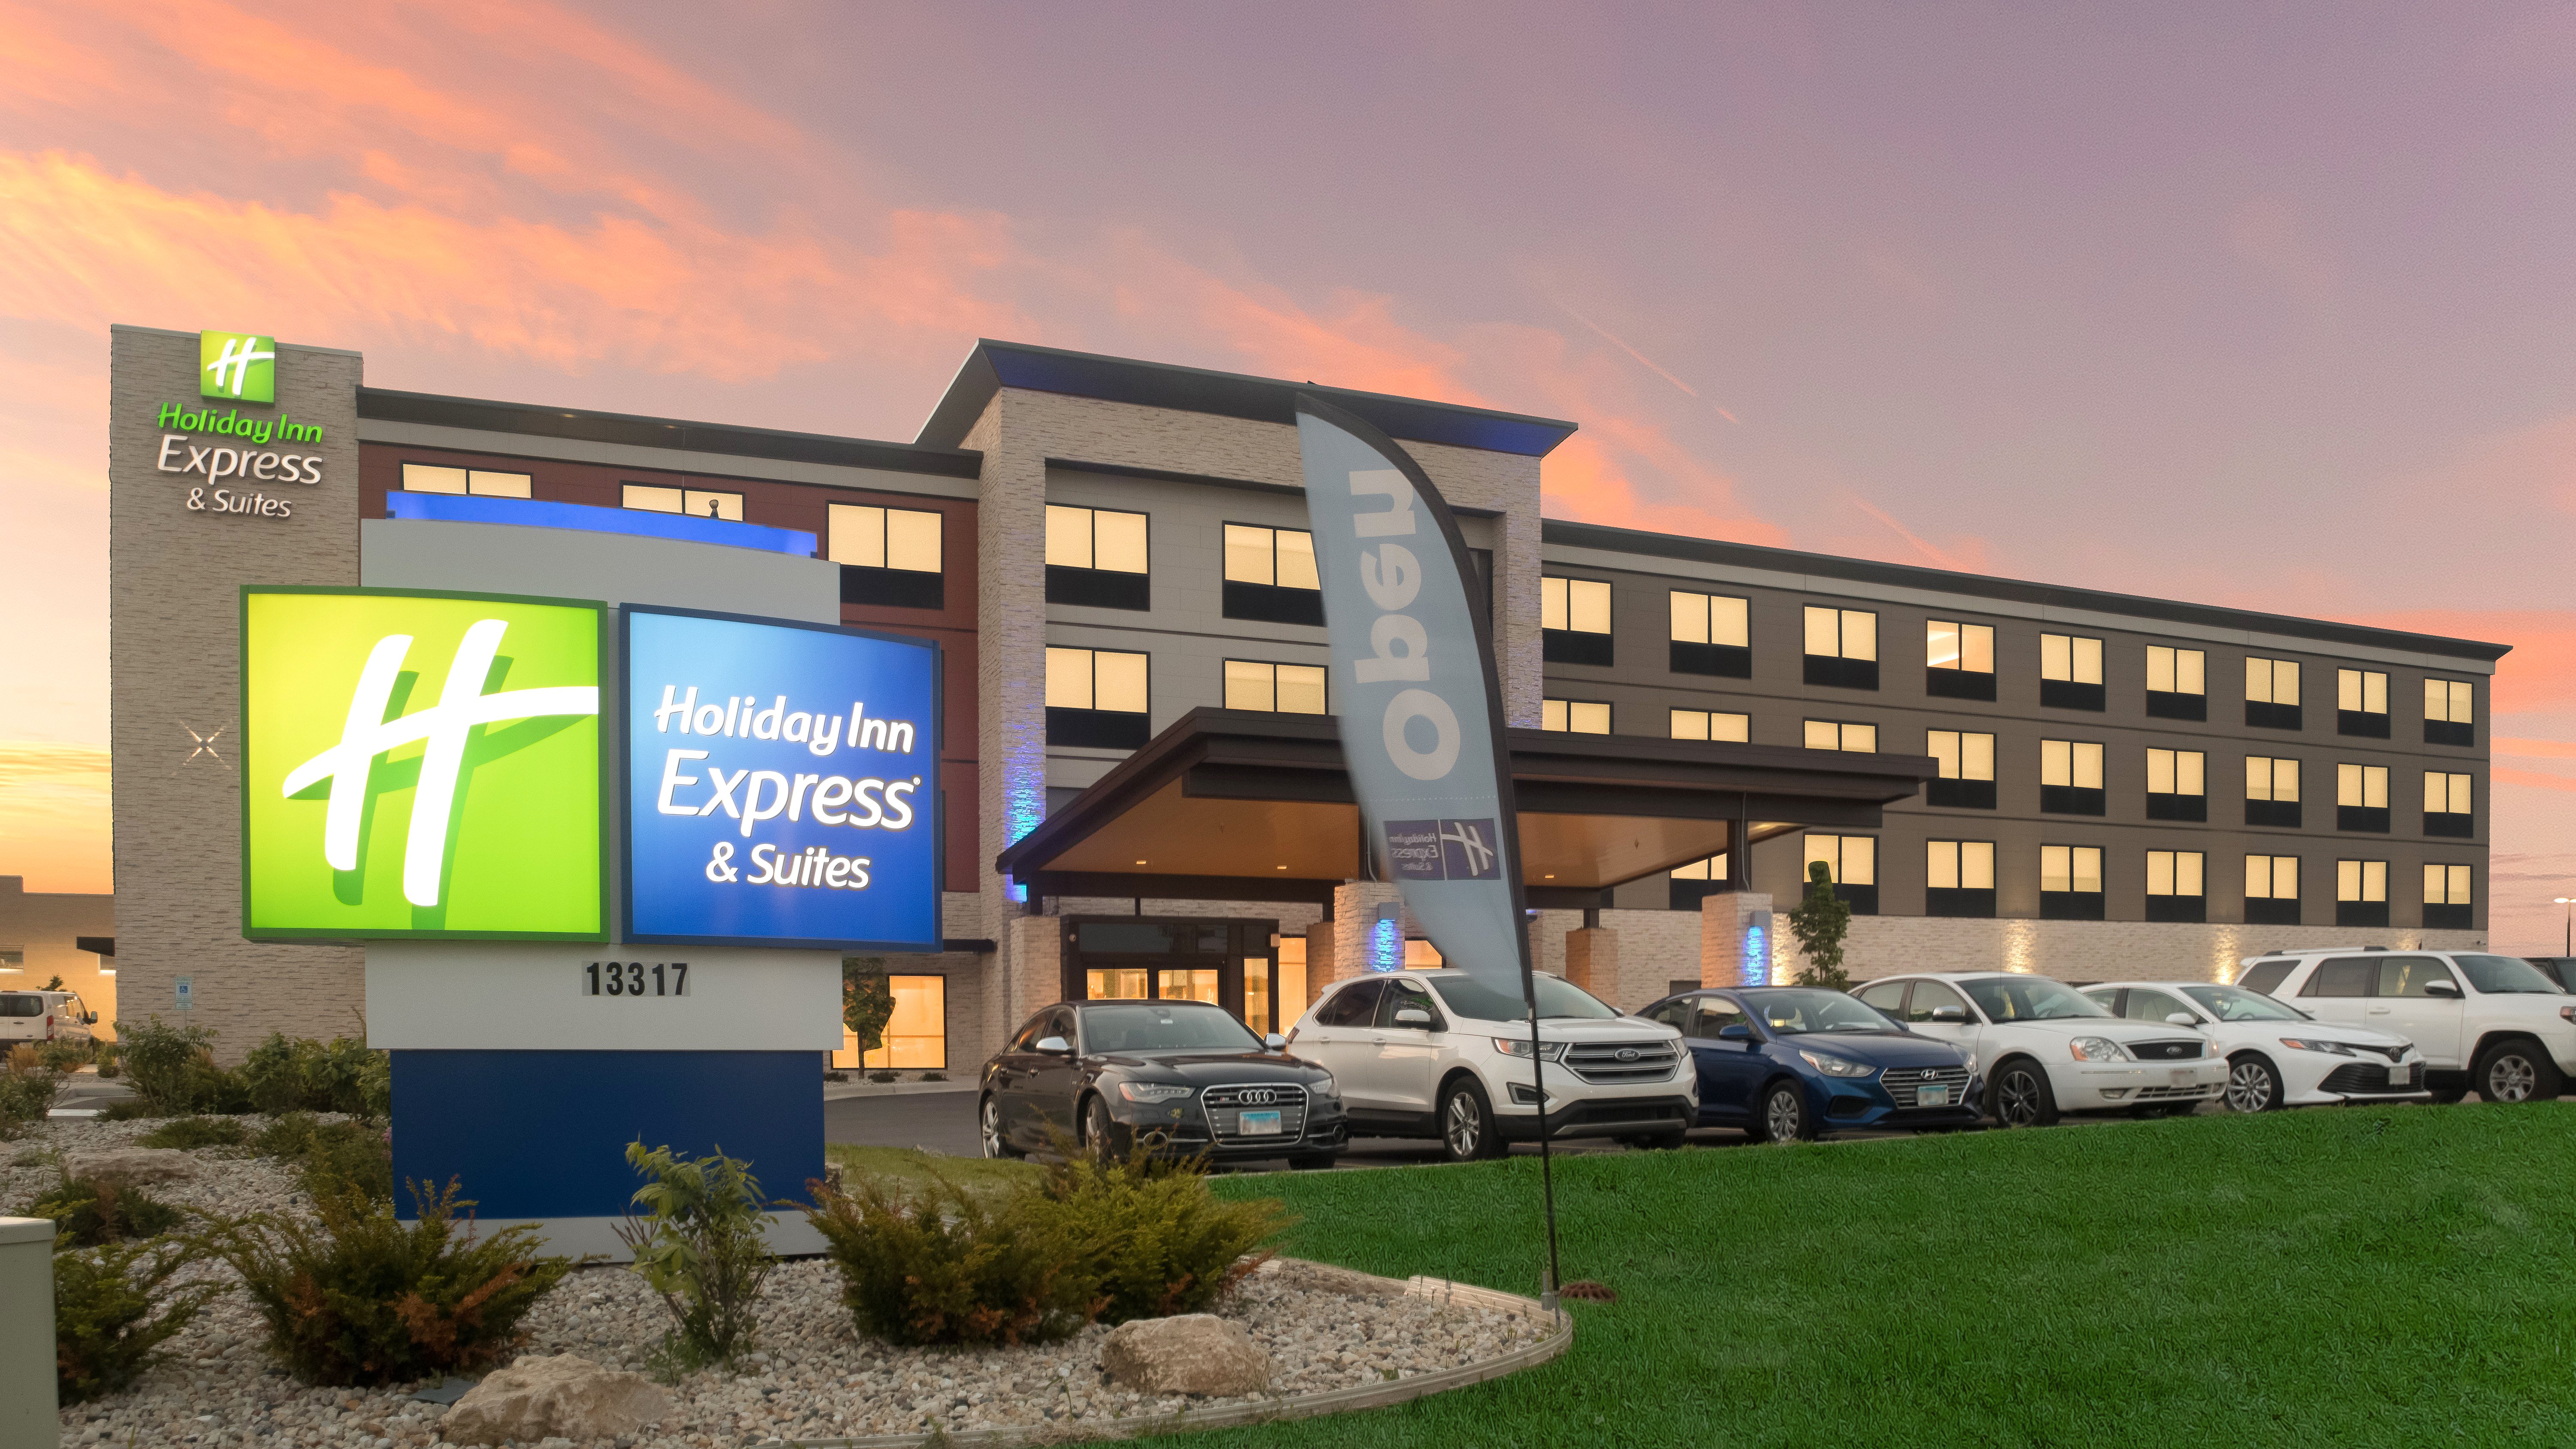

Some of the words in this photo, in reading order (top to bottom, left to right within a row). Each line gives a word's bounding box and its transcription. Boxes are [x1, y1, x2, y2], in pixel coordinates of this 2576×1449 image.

[157, 402, 273, 444] Holiday
[277, 413, 323, 444] Inn
[158, 434, 323, 485] Express
[187, 487, 205, 511] &
[212, 489, 292, 517] Suites
[653, 684, 843, 756] Holiday
[848, 701, 914, 754] Inn
[705, 841, 739, 883] &
[747, 843, 871, 889] Suites
[586, 962, 688, 996] 13317
